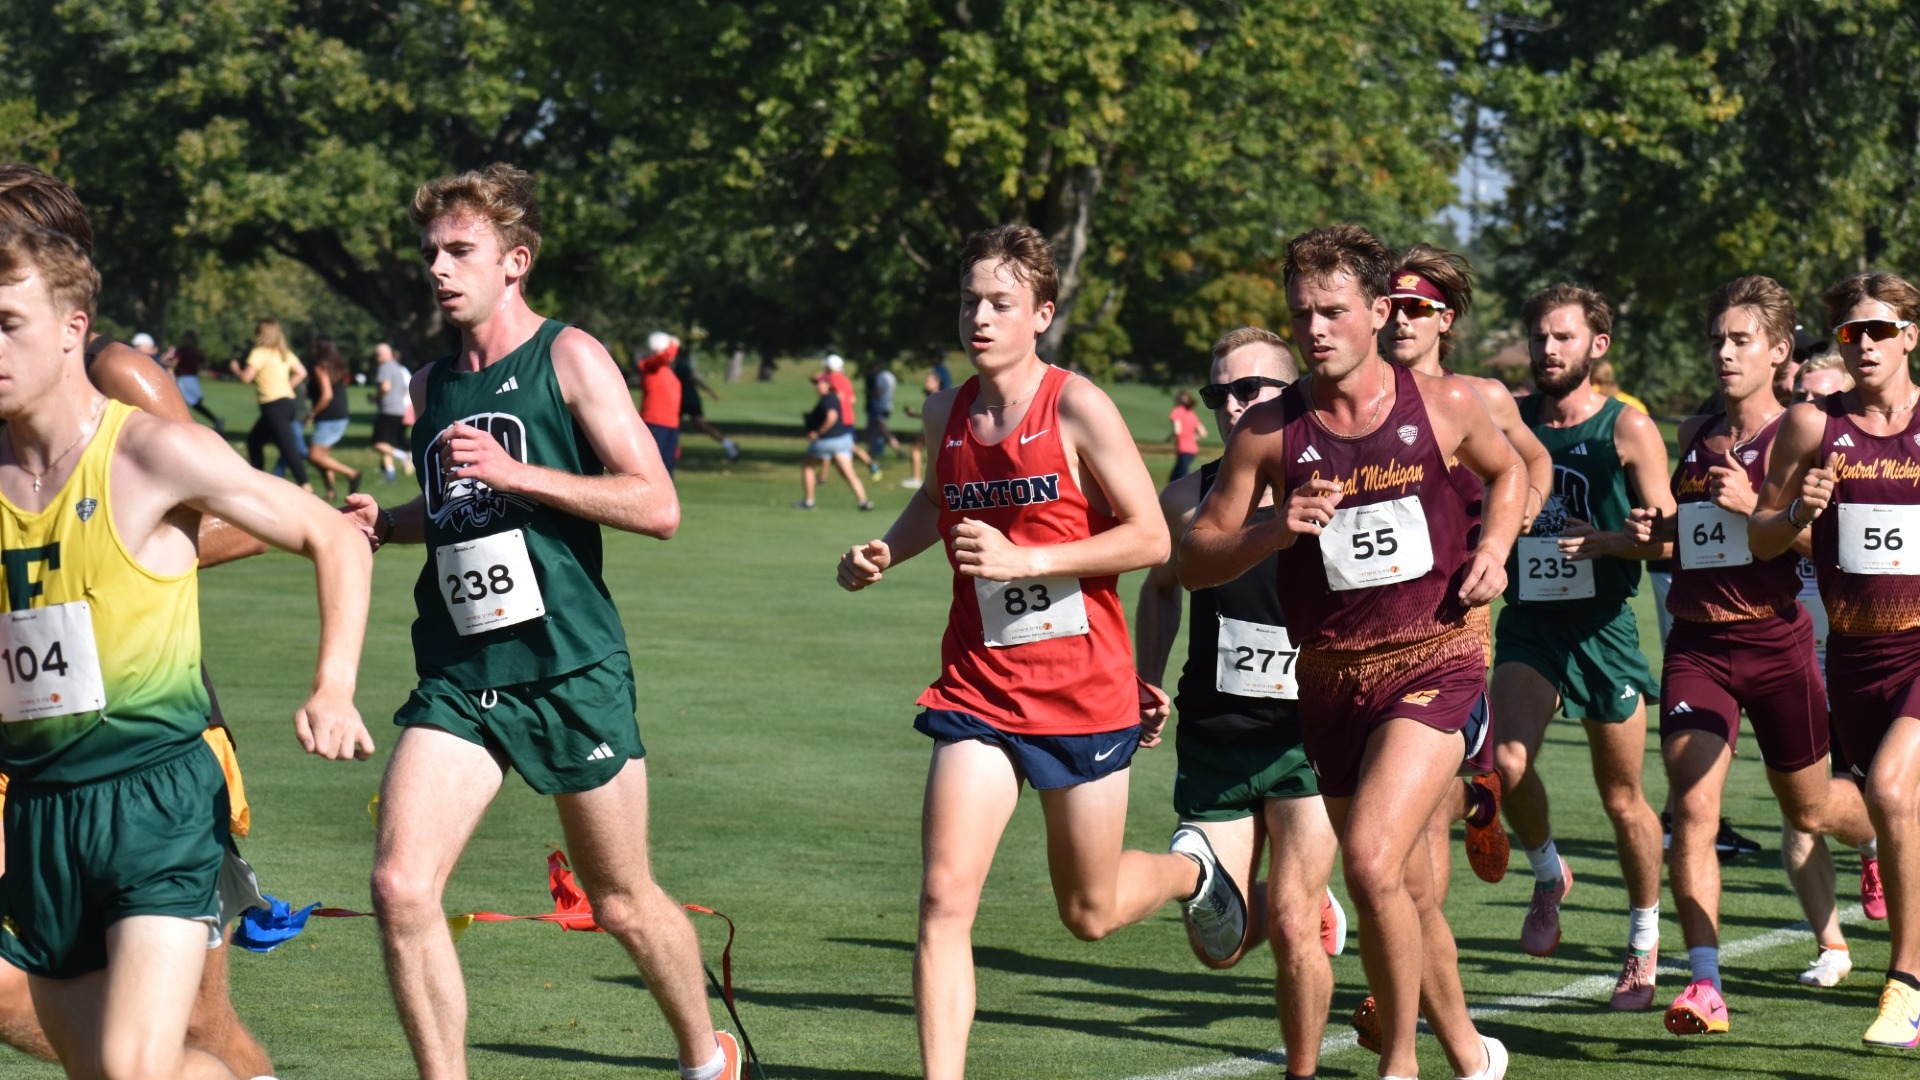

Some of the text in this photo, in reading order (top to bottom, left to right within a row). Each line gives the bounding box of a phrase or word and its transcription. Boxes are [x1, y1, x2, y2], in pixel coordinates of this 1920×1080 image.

[1360, 457, 1425, 494] Michigan
[1834, 453, 1879, 482] Central
[943, 473, 1060, 512] DAYTON
[1352, 527, 1398, 561] 55
[1693, 521, 1726, 546] 64
[1863, 527, 1904, 551] 56
[1528, 557, 1578, 579] 235
[446, 564, 514, 605] 238
[1004, 584, 1052, 616] 83
[2, 641, 69, 684] 104
[1235, 645, 1297, 675] 277
